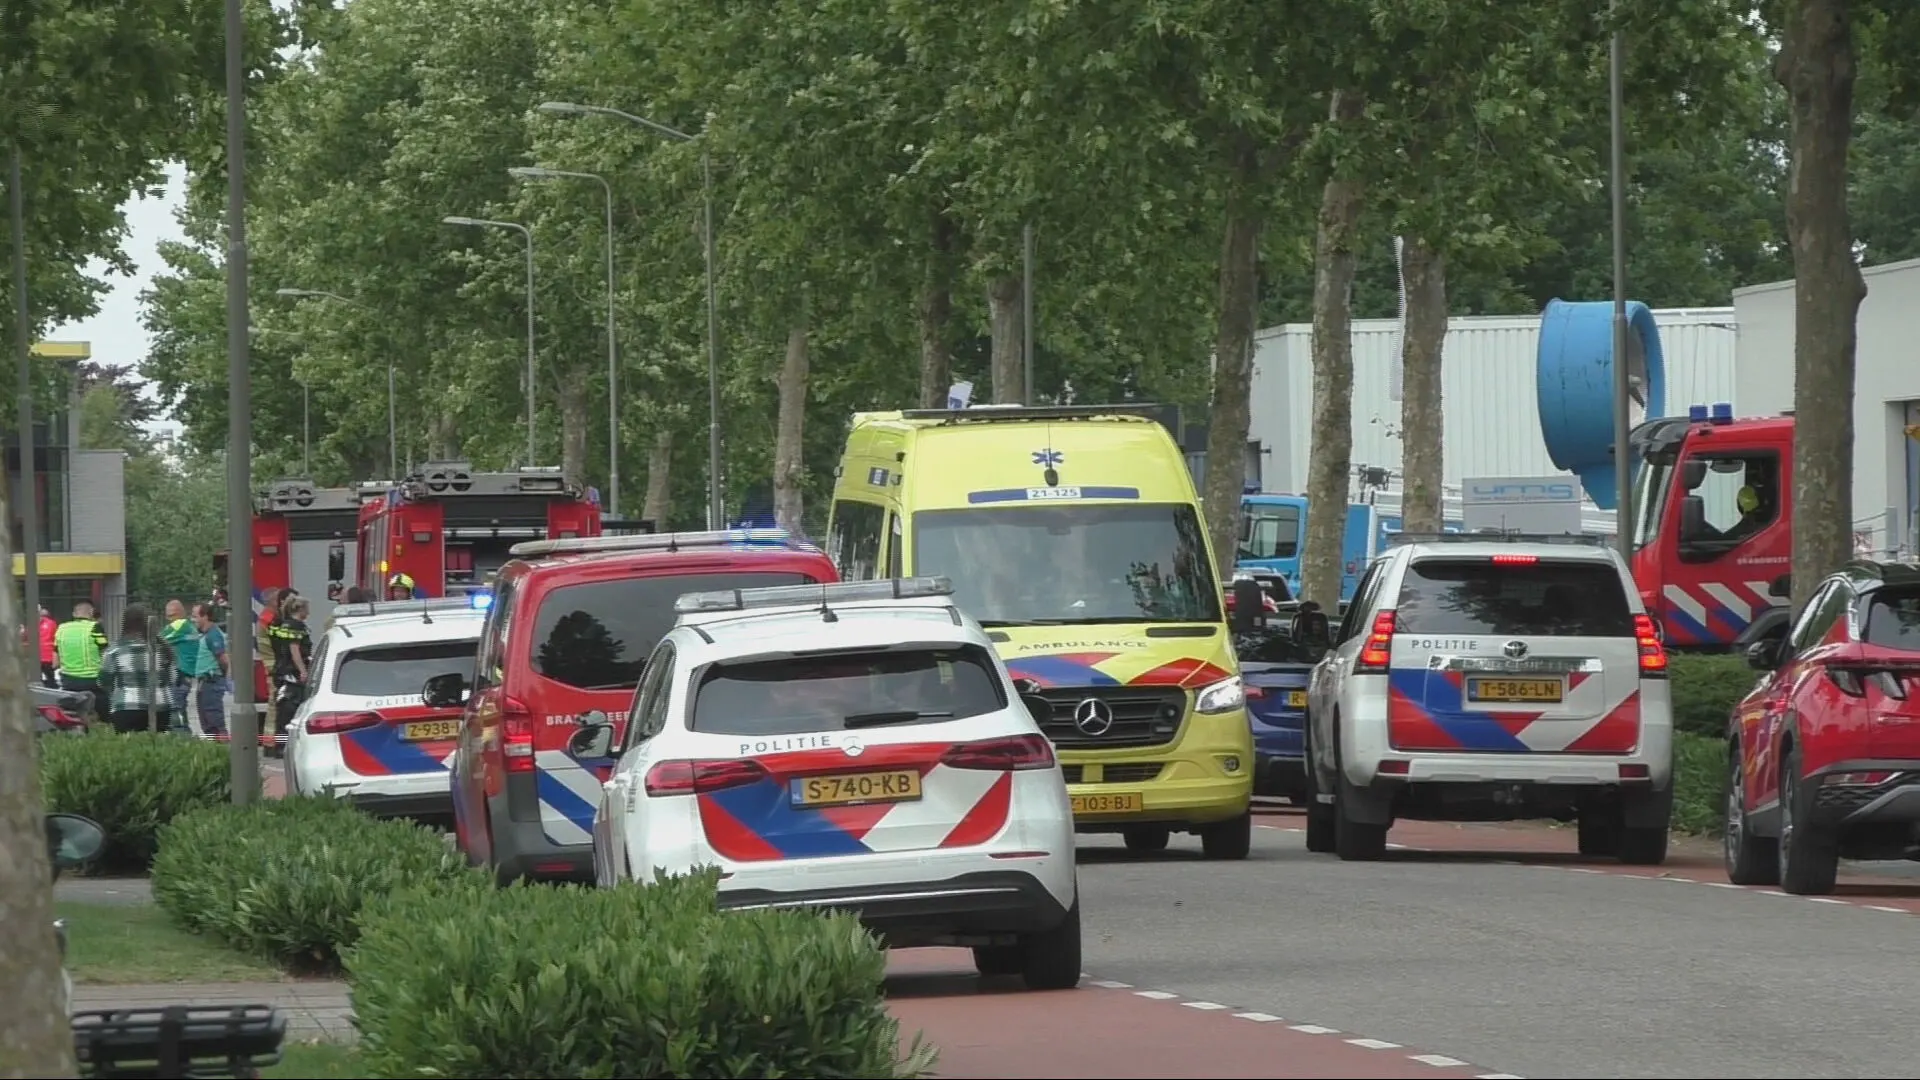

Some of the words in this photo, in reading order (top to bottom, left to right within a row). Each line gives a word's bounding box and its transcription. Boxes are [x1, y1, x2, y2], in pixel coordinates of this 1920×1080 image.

[1031, 488, 1077, 498] 21-125
[1018, 640, 1148, 651] AMBULANCE
[1411, 639, 1479, 650] POLITIE
[1481, 682, 1555, 697] T-586-LN
[740, 735, 832, 755] POLITIE
[808, 774, 912, 799] S-740-KB
